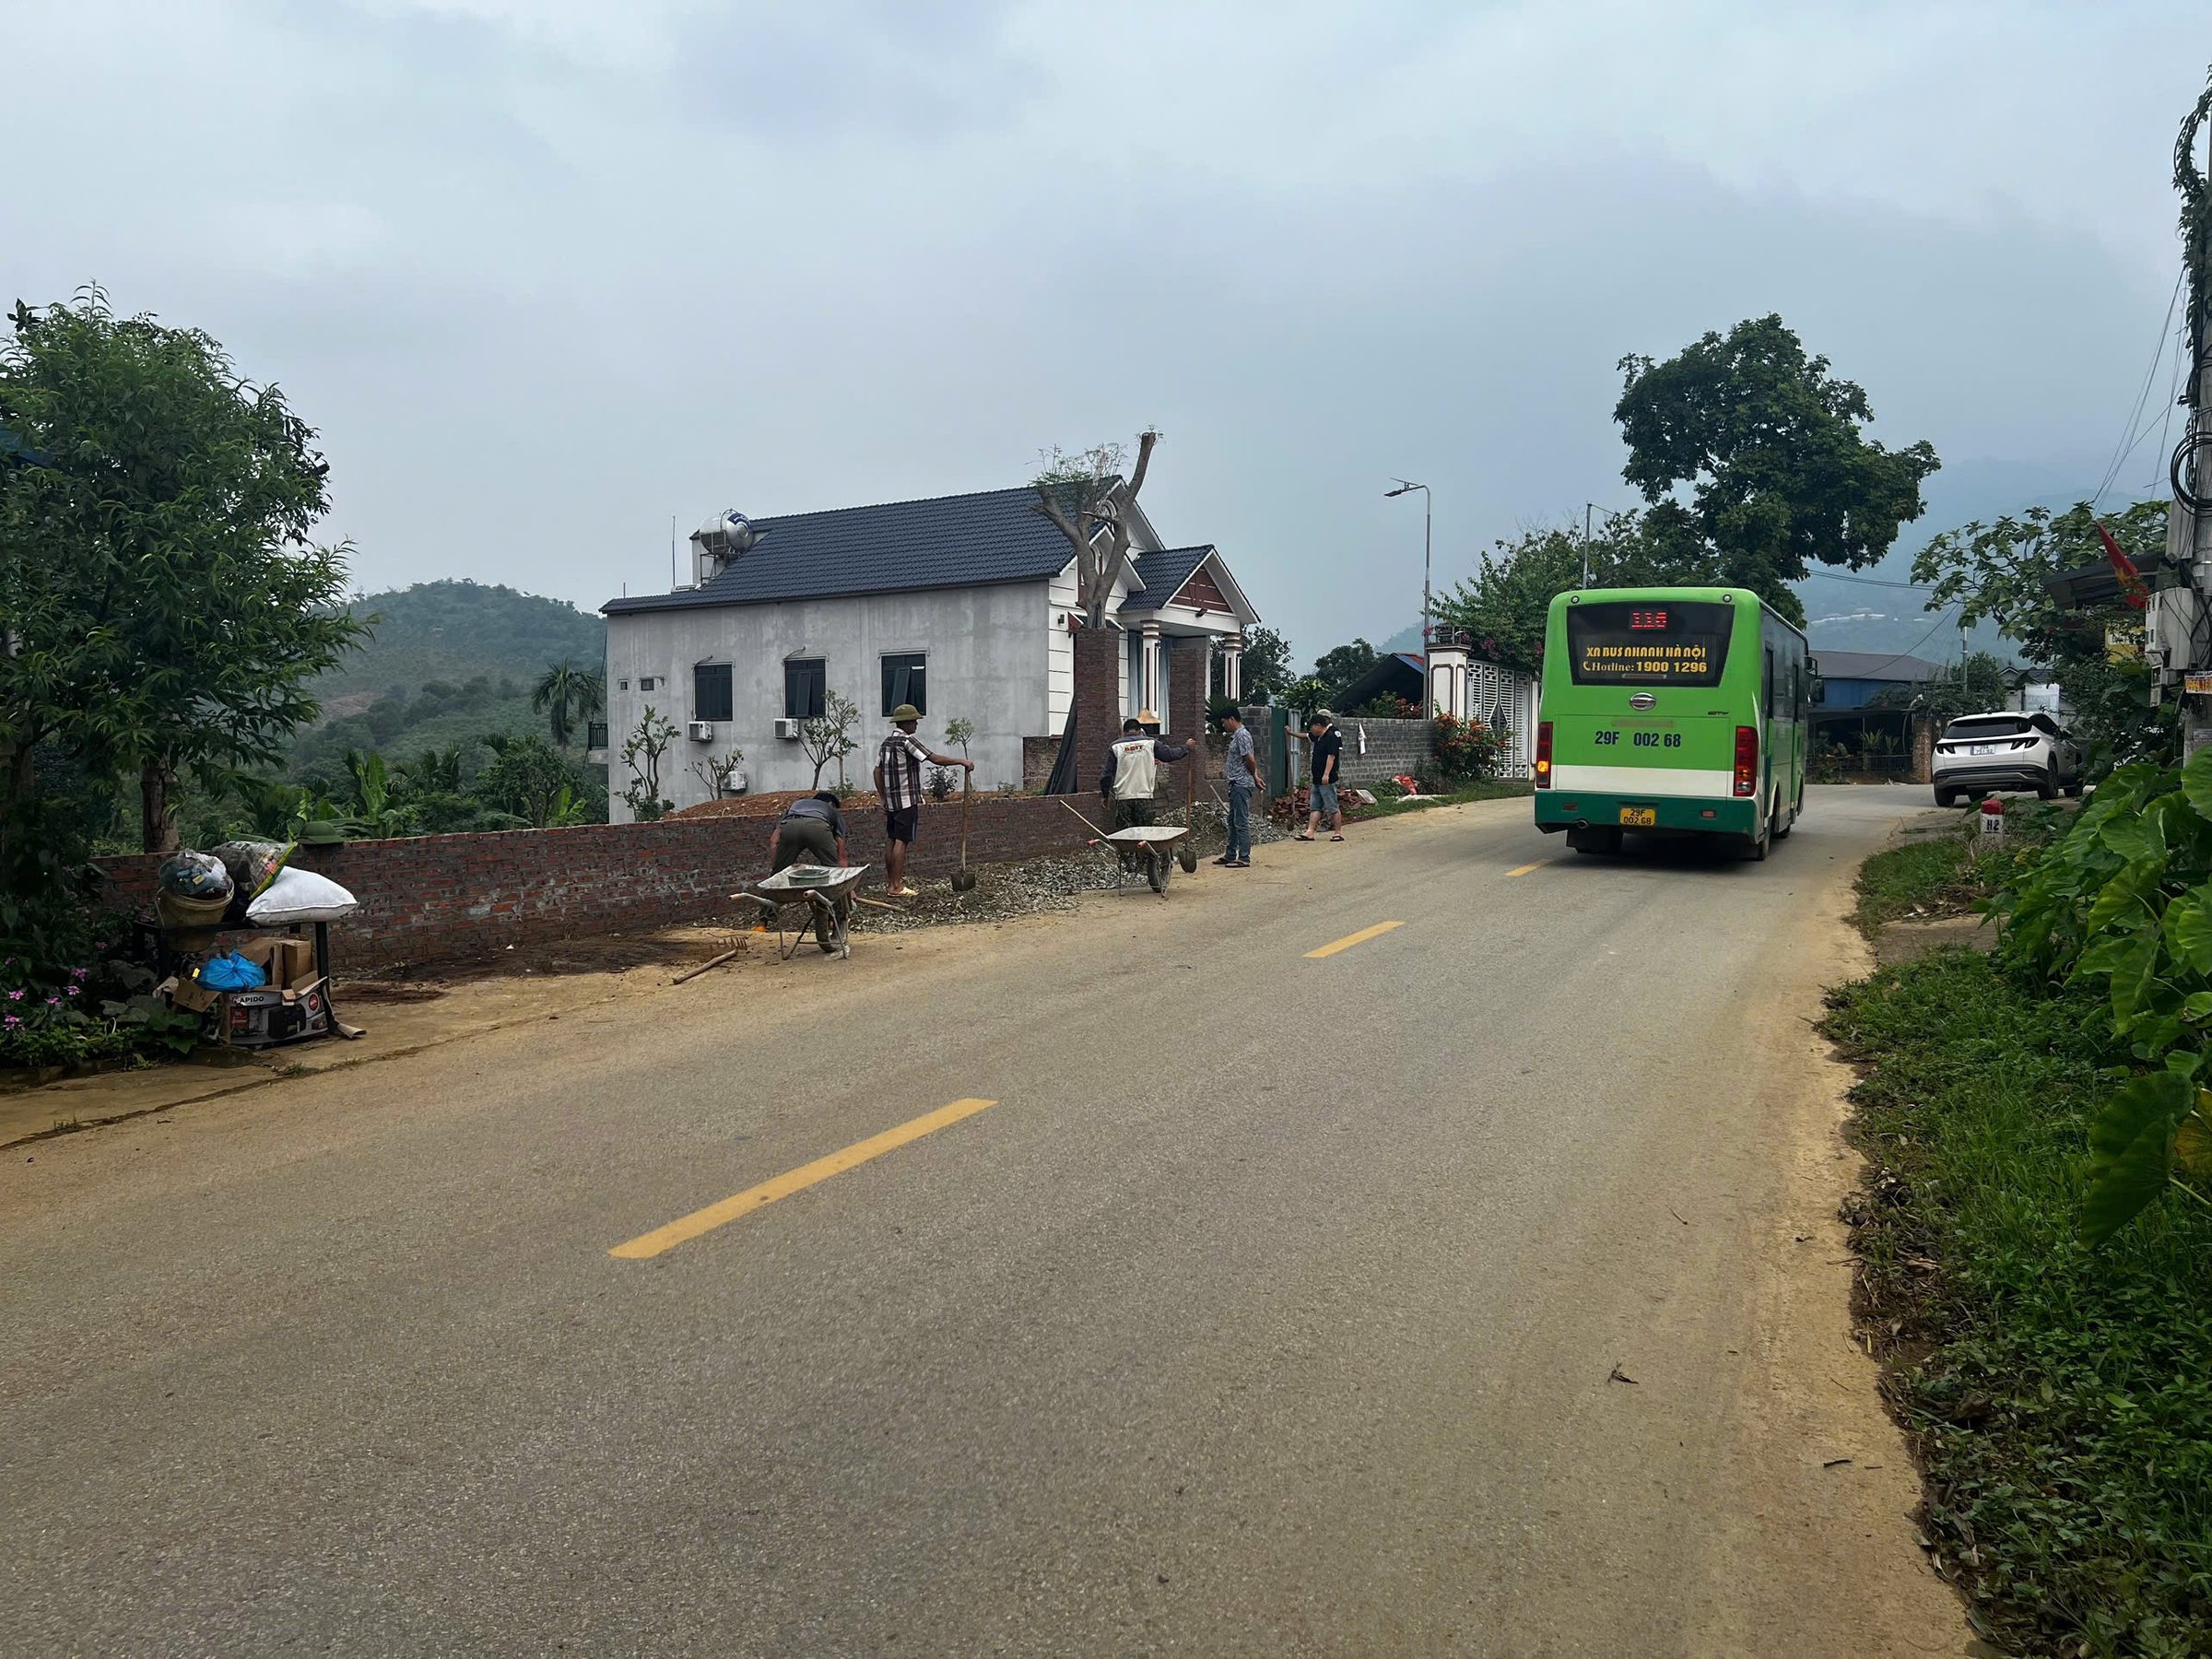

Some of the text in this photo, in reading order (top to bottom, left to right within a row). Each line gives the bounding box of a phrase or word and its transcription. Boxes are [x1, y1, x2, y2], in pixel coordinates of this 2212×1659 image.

[1602, 647, 1623, 657] BUS
[1665, 643, 1681, 657] HÀ
[1684, 644, 1706, 660] NỘI
[1592, 662, 1707, 673] Hotline: 1900 1296
[1594, 731, 1619, 745] 29F
[1987, 819, 2000, 830] H2
